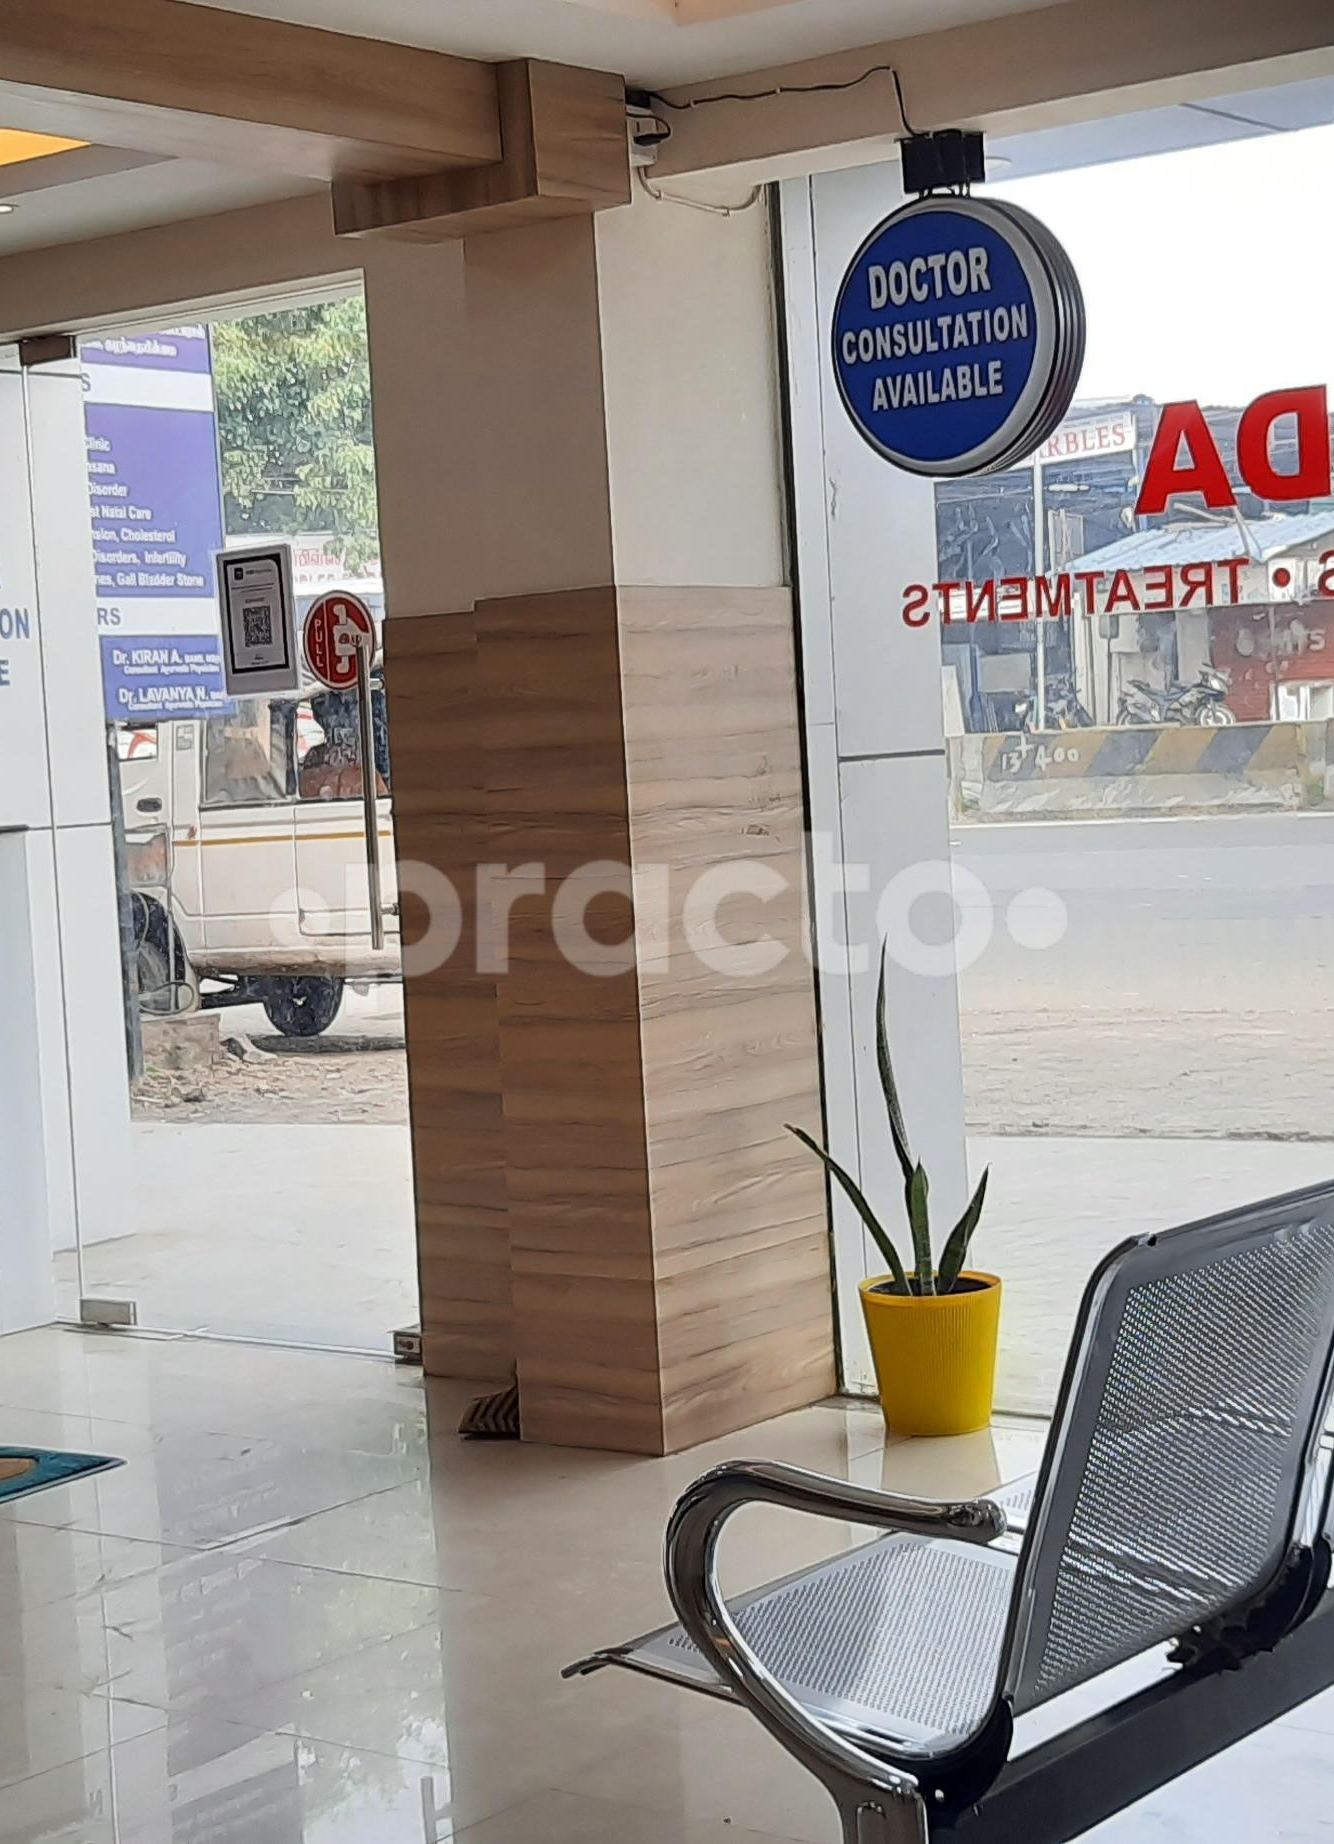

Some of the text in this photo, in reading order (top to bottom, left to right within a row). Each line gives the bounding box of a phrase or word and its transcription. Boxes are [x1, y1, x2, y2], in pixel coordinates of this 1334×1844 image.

[868, 247, 991, 310] DOCTOR
[841, 303, 1028, 365] CONSULTATION
[872, 360, 1003, 411] AVAILABLE
[101, 506, 127, 519] Natal
[128, 506, 152, 520] Care
[120, 528, 176, 543] Cholesterol
[144, 551, 187, 568] Infertility
[117, 572, 137, 586] Gall
[138, 573, 175, 587] Bladder
[176, 573, 204, 587] Stone
[314, 618, 324, 668] PULL
[113, 650, 130, 664] Dr.
[132, 649, 167, 664] KIRAN
[138, 686, 195, 701] LAVANYA
